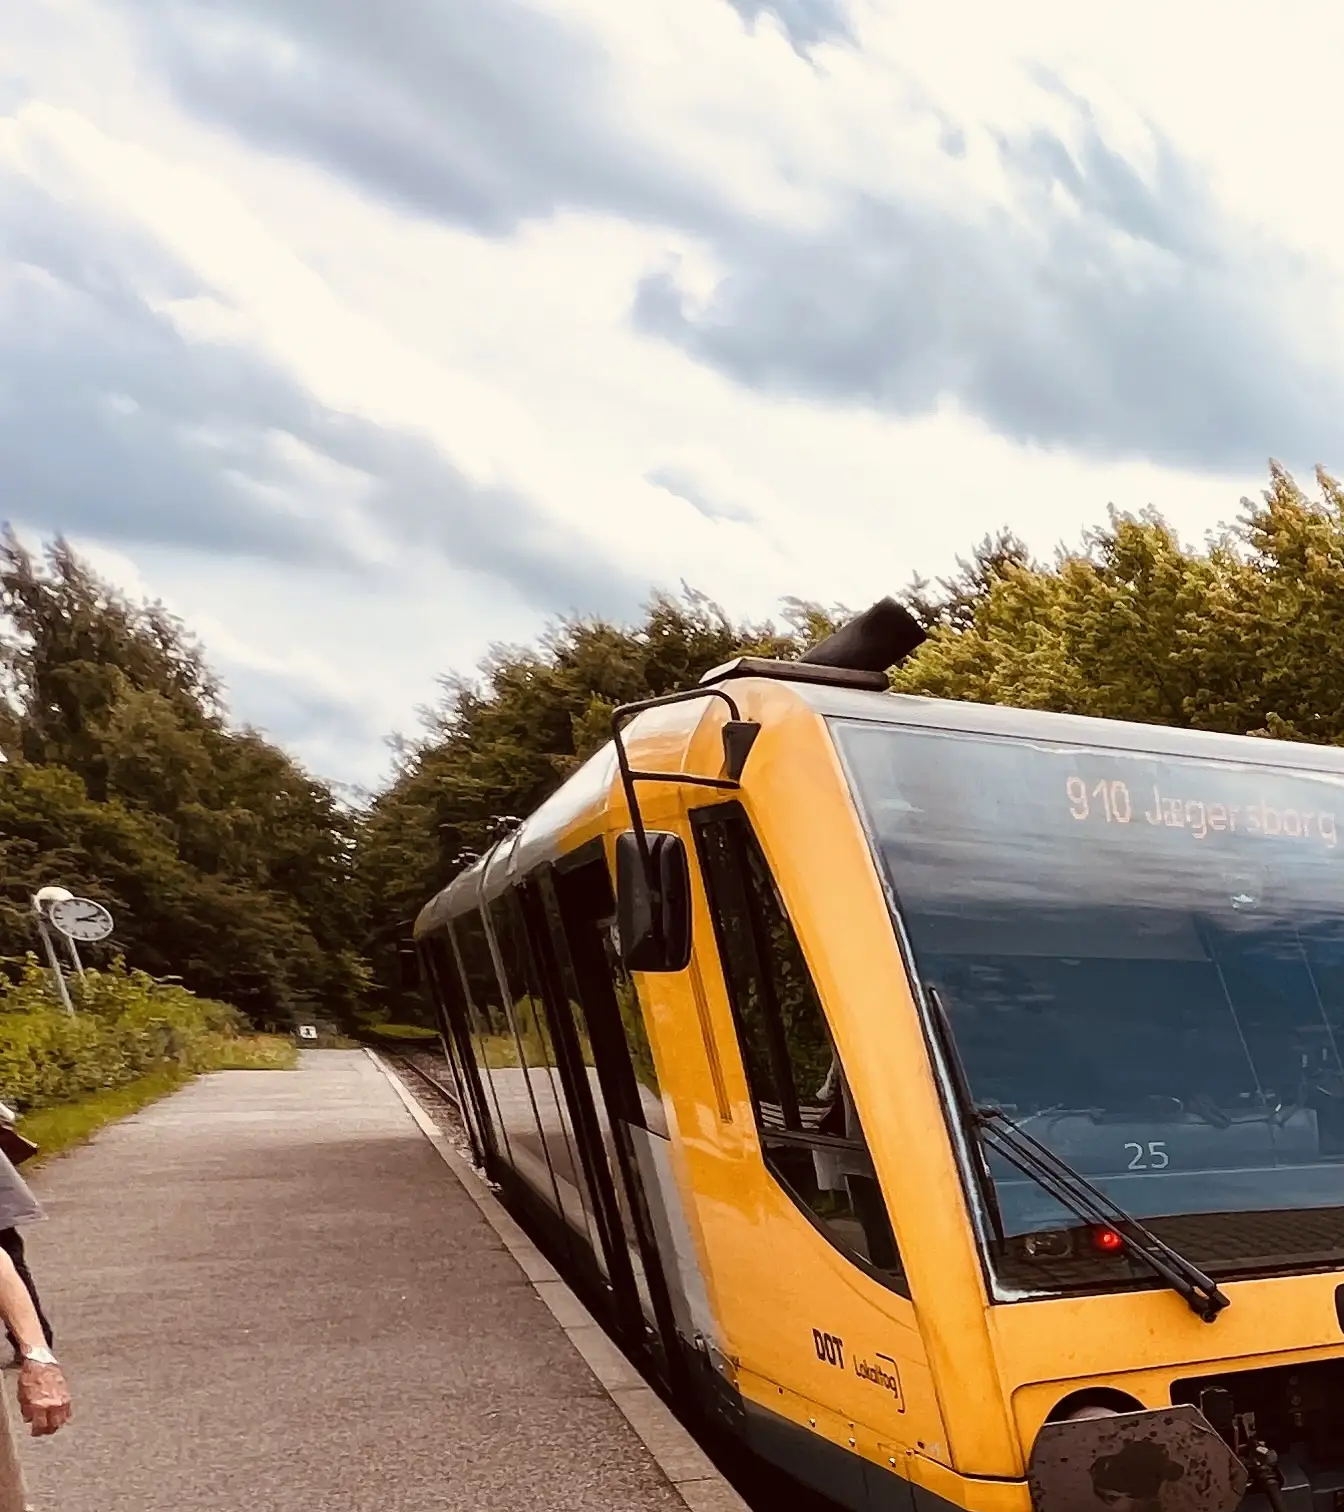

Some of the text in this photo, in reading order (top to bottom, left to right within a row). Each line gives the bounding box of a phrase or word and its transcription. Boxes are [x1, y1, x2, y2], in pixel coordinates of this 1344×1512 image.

[1066, 776, 1131, 823] 910
[1124, 1141, 1170, 1170] 25
[811, 1327, 845, 1370] DOT
